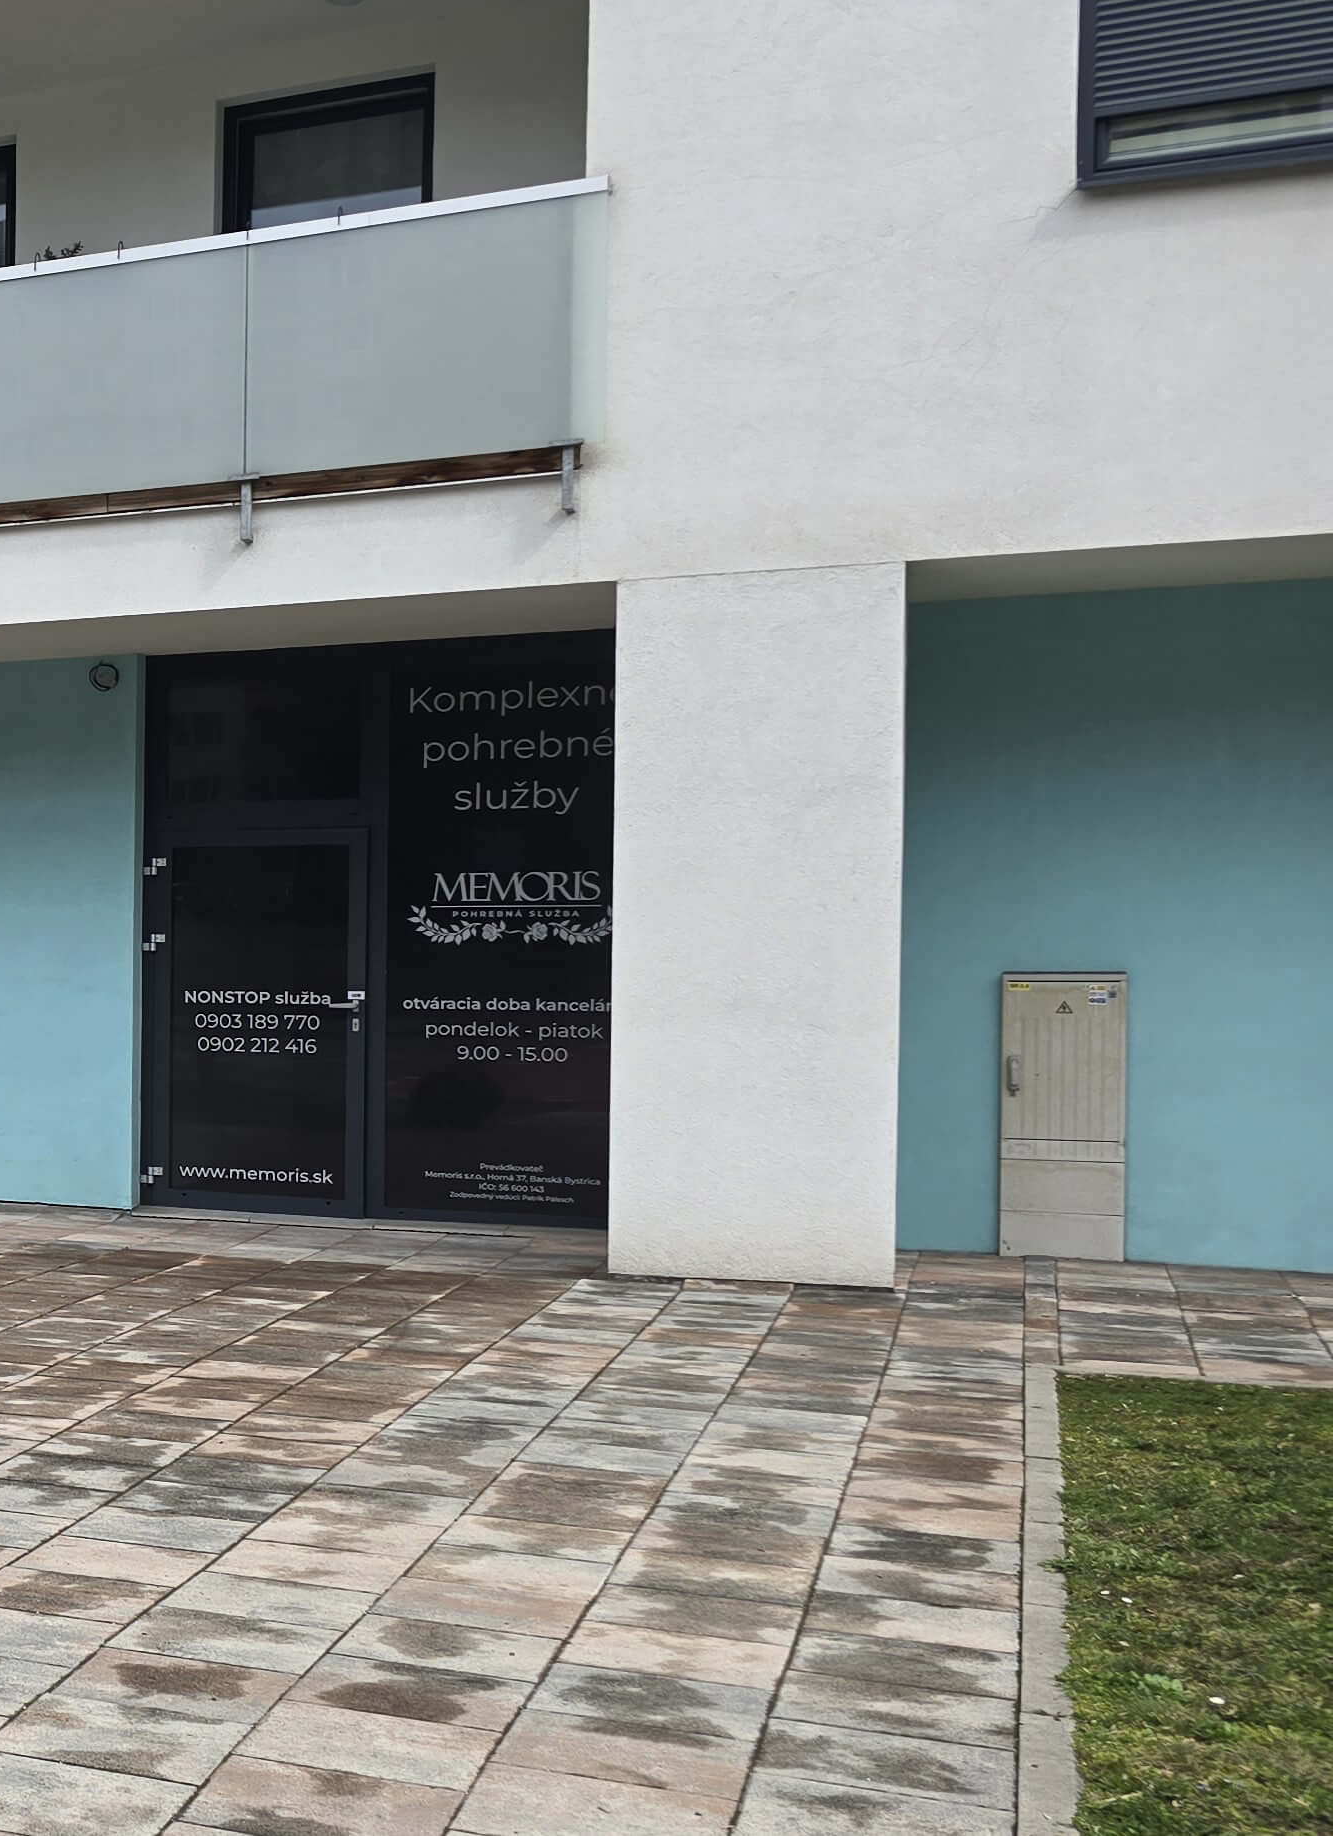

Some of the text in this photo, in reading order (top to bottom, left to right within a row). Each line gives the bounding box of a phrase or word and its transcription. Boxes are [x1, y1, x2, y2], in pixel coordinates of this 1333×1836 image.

[409, 680, 616, 717] Komplexn
[423, 727, 614, 769] pohrebné
[453, 780, 580, 815] služby
[432, 871, 602, 902] MEMORIS
[452, 908, 581, 918] POHREBNÁ SLUŽBA
[184, 990, 331, 1006] NONSTOP služba
[403, 996, 482, 1011] otváracia
[486, 998, 531, 1011] doba
[194, 1013, 321, 1031] 0903 189 770
[425, 1021, 520, 1039] pondelok
[538, 1022, 604, 1041] piatok
[197, 1036, 318, 1054] 0902 212 416
[456, 1045, 500, 1061] 9.00
[517, 1046, 569, 1063] 15.00
[179, 1165, 334, 1185] www.memoris.sk
[424, 1170, 463, 1179] Memoris
[487, 1173, 514, 1182] Horná
[530, 1175, 563, 1184] Banská
[565, 1176, 601, 1186] Bystrica
